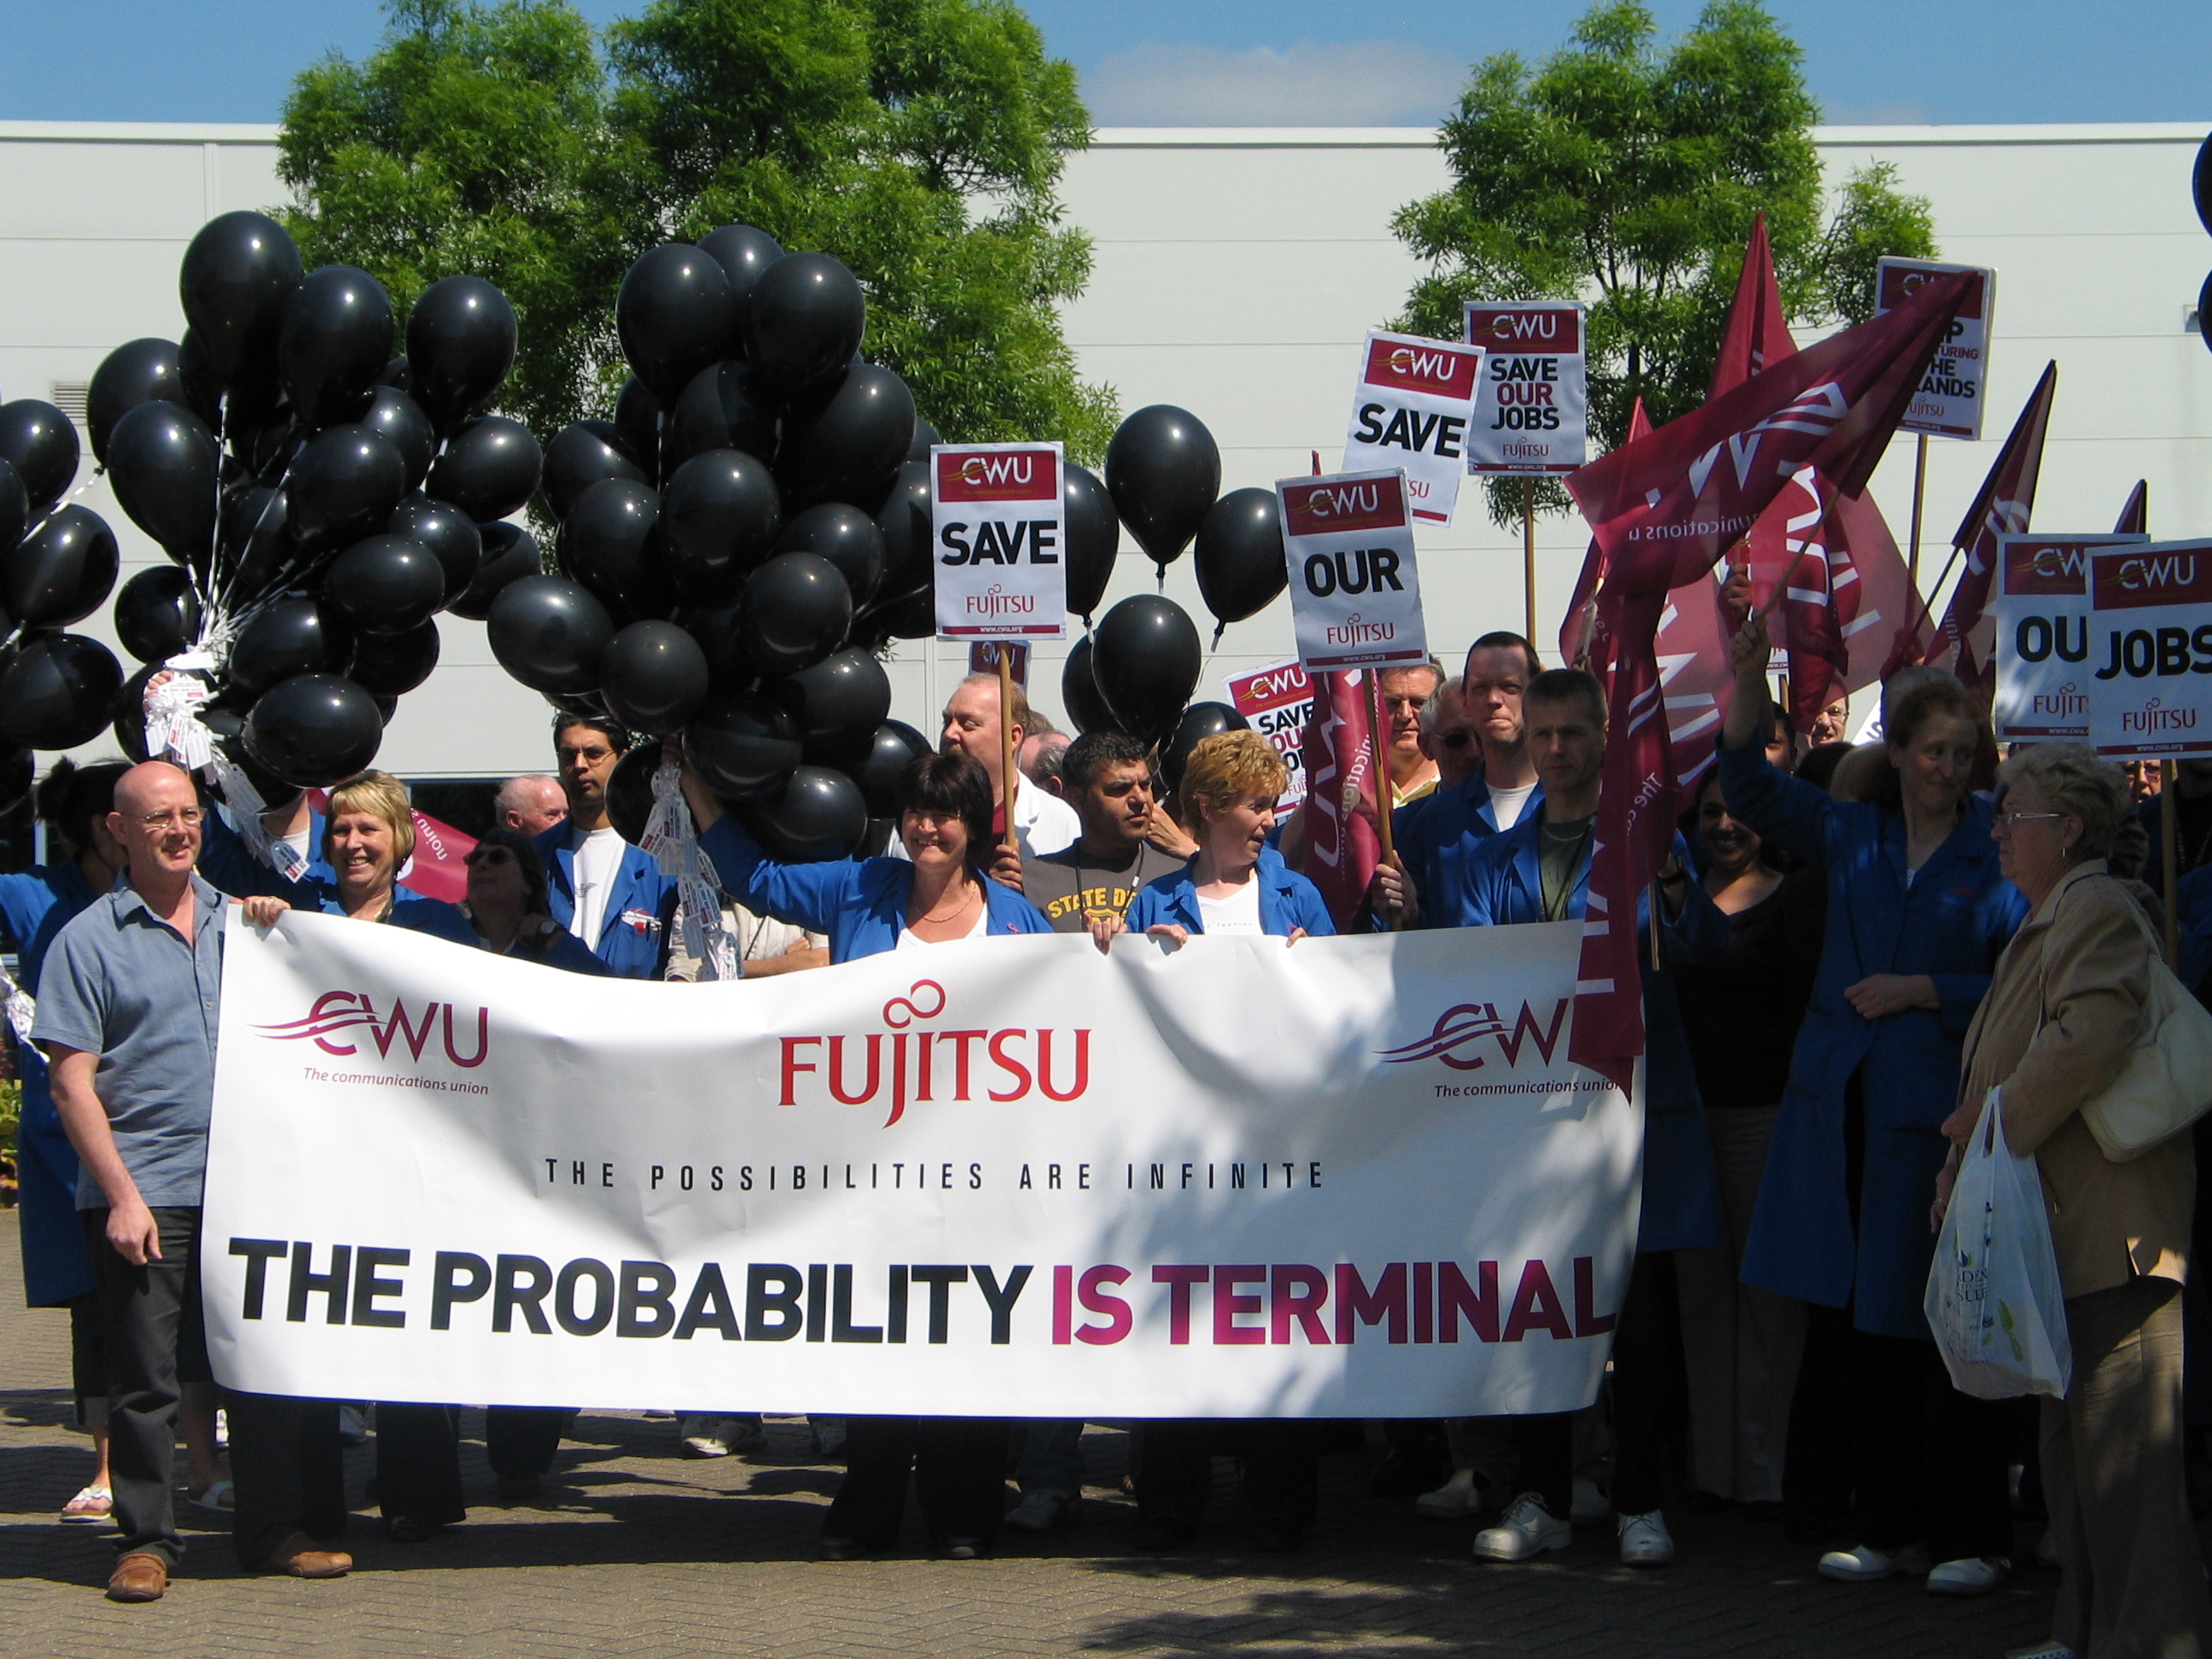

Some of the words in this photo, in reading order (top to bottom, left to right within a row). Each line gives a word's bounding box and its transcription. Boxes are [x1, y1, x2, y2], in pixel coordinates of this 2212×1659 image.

[1492, 314, 1557, 339] CWU
[1390, 347, 1457, 381] CWU
[1490, 358, 1559, 381] SAVE
[1930, 358, 1957, 377] HE
[1496, 382, 1553, 406] OUR
[1491, 406, 1560, 430] JOBS
[1910, 403, 1944, 416] UJITSU
[1354, 403, 1466, 458] SAVE
[1502, 443, 1549, 459] FUJITSU
[961, 456, 1033, 486] CWU
[1308, 484, 1379, 516] CWU
[940, 520, 1058, 565] SAVE
[1304, 548, 1405, 597] OUR
[2033, 548, 2086, 577] CW
[2119, 556, 2195, 589] CWU
[966, 594, 1034, 619] FUJITSU
[1326, 622, 1395, 648] FUJITSU
[2016, 615, 2087, 662] OU
[2094, 625, 2212, 680] JOBS
[1250, 667, 1307, 699] CWU
[2033, 695, 2089, 719] FUJIT
[2122, 708, 2197, 736] FUJITSU
[1270, 727, 1304, 754] OU
[1047, 887, 1107, 919] STATE
[310, 990, 489, 1068] CWU
[1434, 998, 1575, 1070] CW
[303, 1067, 329, 1082] The
[331, 1070, 447, 1091] communications
[450, 1081, 489, 1096] union
[777, 1027, 1092, 1129] FUJITSU
[1435, 1085, 1460, 1097] The
[1464, 1079, 1579, 1096] communications
[545, 1158, 614, 1188] THE
[651, 1162, 982, 1191] POSSIBILITIES
[1019, 1162, 1090, 1190] ARE
[1127, 1161, 1322, 1190] INFINITE
[228, 1237, 411, 1329] THE
[429, 1249, 1034, 1345] PROBABILITY
[1051, 1264, 1133, 1346] IS
[1151, 1255, 1617, 1346] TERMINAL
